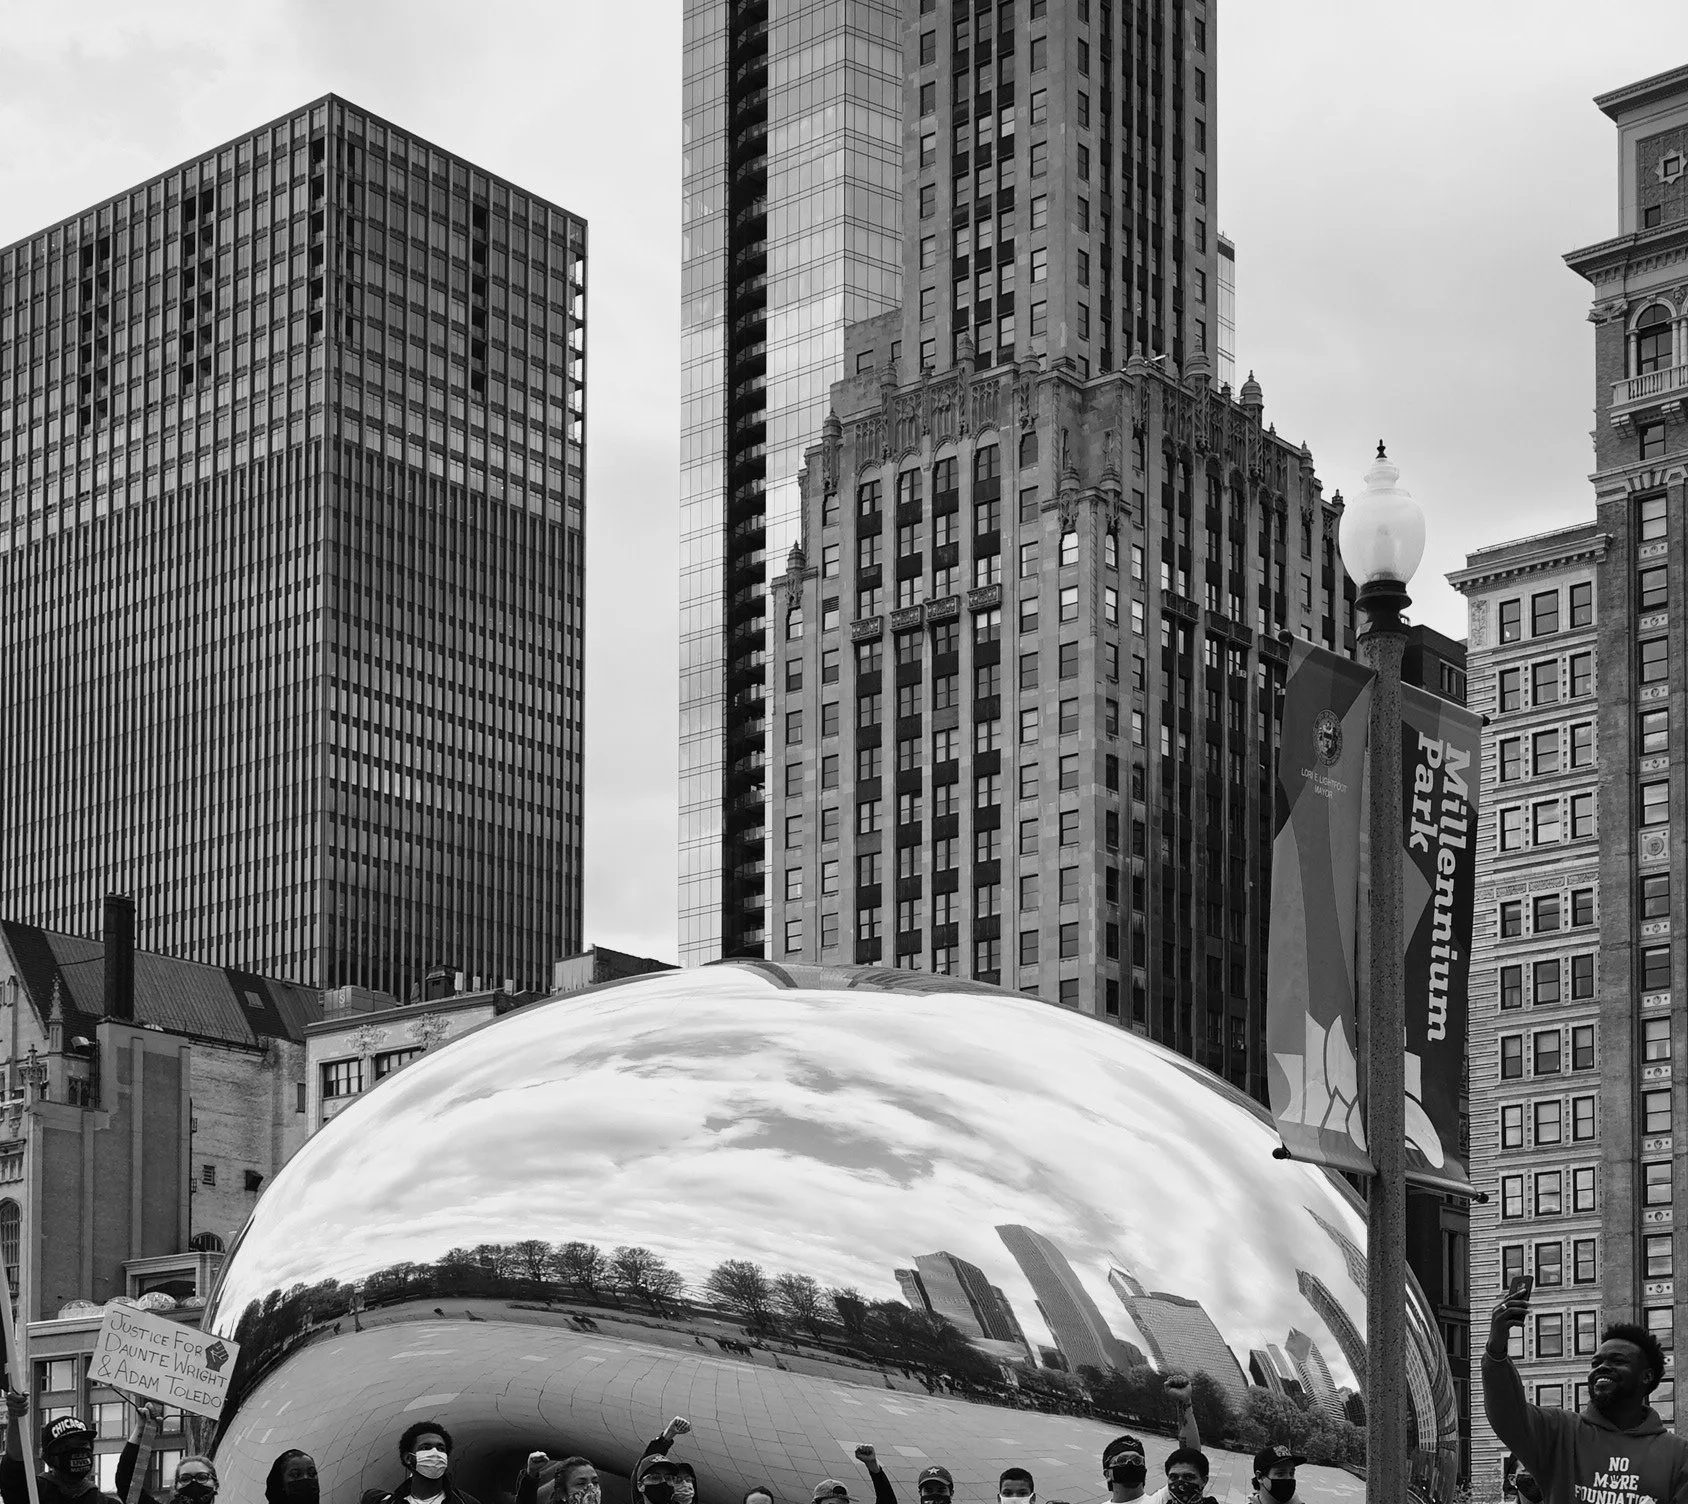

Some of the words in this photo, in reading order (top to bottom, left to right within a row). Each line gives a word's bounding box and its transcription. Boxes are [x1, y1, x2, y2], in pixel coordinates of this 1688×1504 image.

[1314, 784, 1334, 799] MAYOR
[1409, 731, 1444, 853] Park
[1427, 742, 1471, 1042] Millennium
[110, 1310, 169, 1347] JUSTICE
[173, 1330, 203, 1357] FOR
[104, 1332, 170, 1368] DAUNTE
[173, 1352, 228, 1388] WRIGHT
[164, 1374, 222, 1408] TOLEDO
[51, 1418, 87, 1438] CHICAGO
[1608, 1456, 1630, 1472] NO
